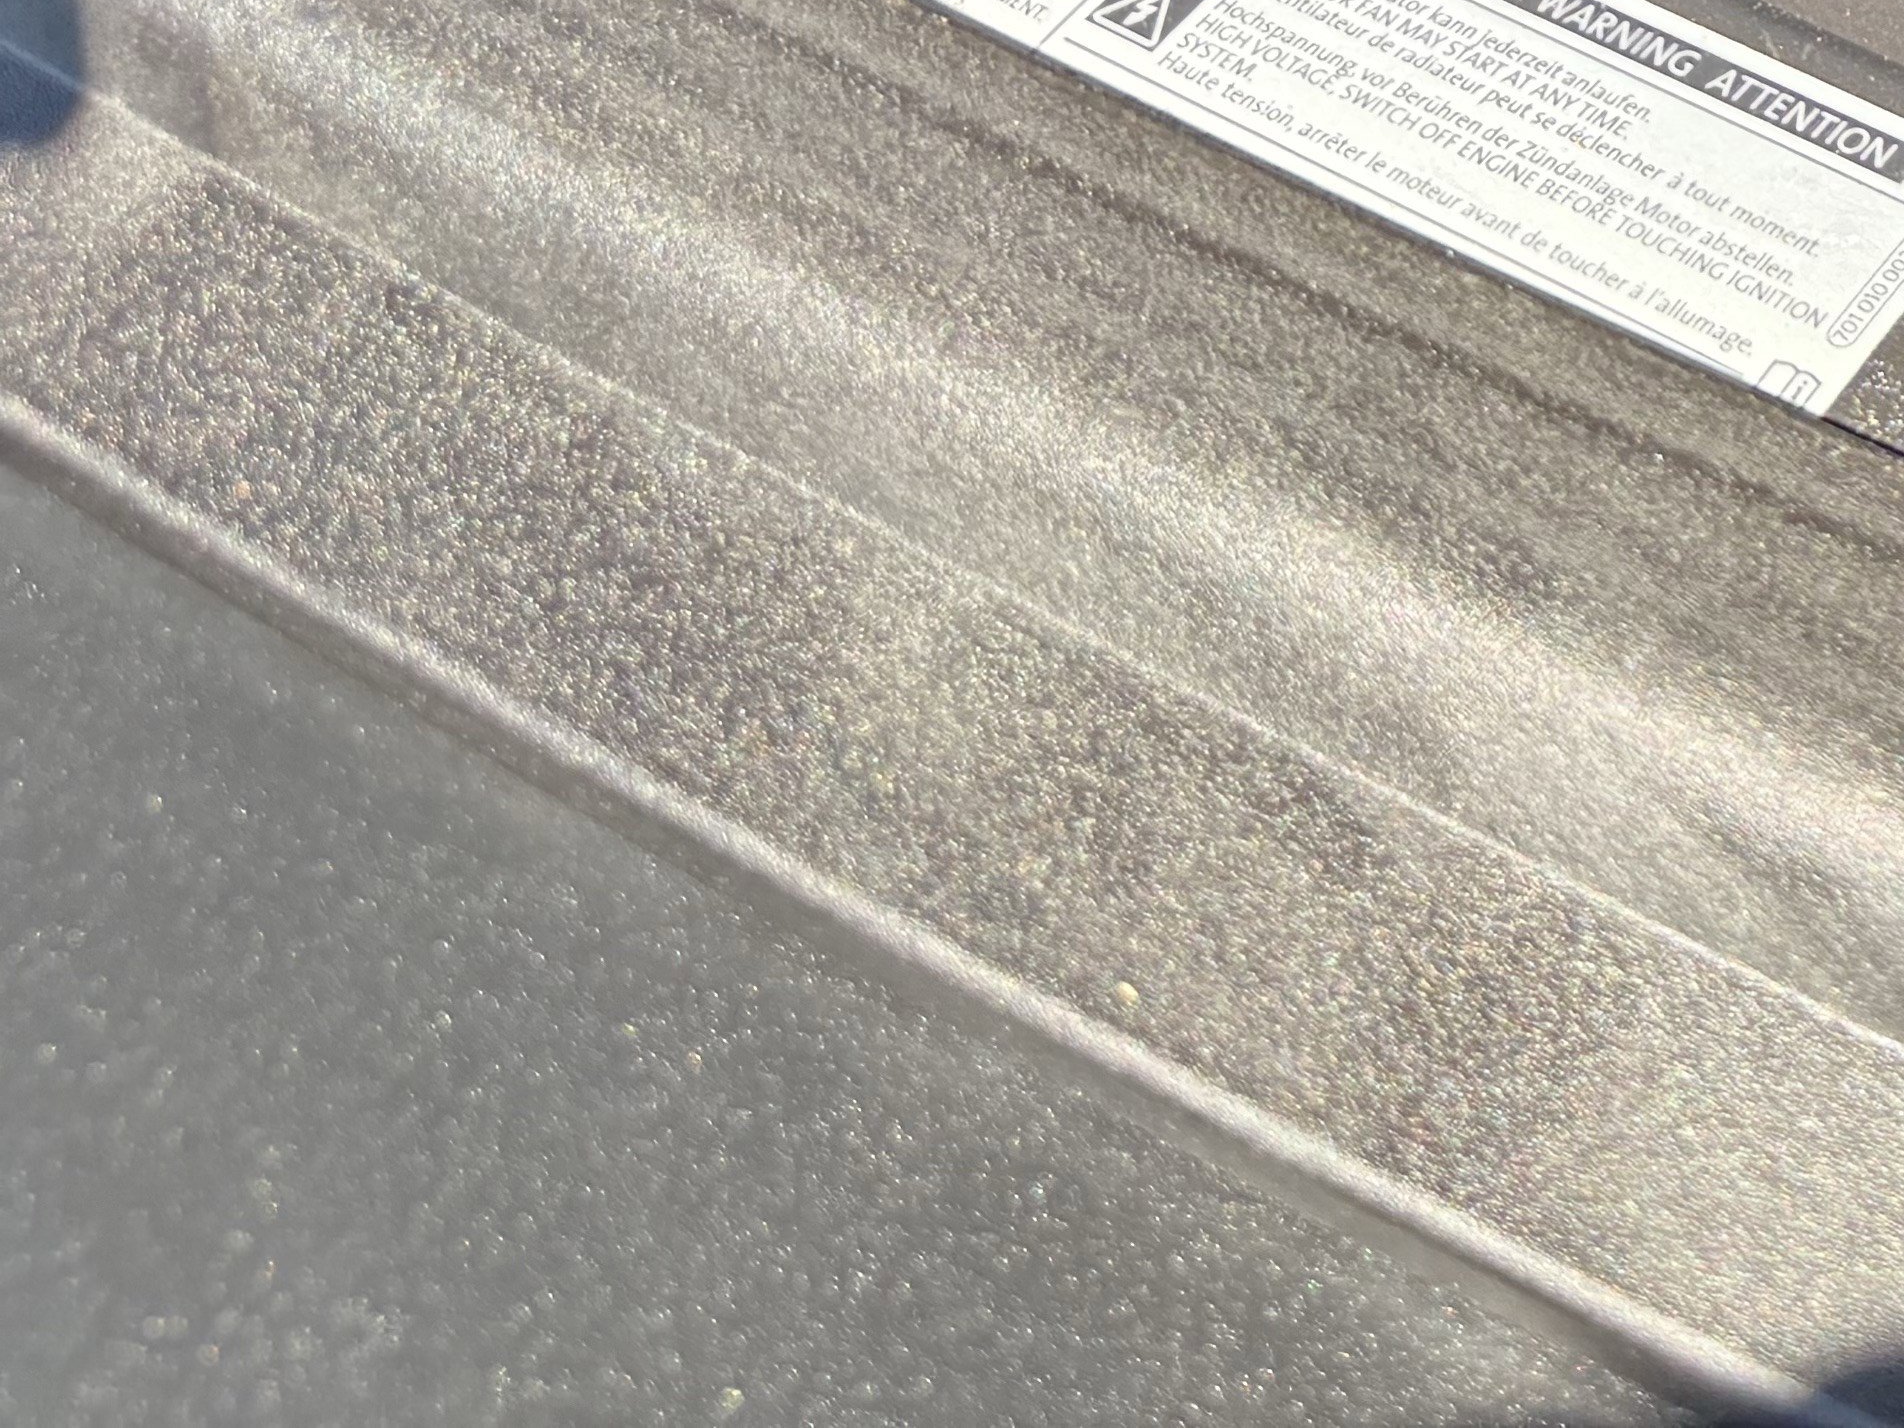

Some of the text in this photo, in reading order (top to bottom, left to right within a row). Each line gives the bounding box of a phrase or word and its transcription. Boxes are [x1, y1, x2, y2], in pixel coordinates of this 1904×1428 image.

[1175, 31, 1258, 82] SYSTEM.
[1393, 16, 1449, 49] MAY
[1441, 39, 1507, 77] START
[1499, 69, 1536, 90] AT
[1528, 81, 1579, 112] ANY
[1575, 101, 1633, 140] TIME.
[1426, 5, 1478, 40] kann
[1470, 28, 1564, 86] jederzeit
[1559, 70, 1651, 123] anlaufen.
[1703, 68, 1899, 169] ATTENTION
[1156, 50, 1220, 91] Haute
[1219, 81, 1295, 133] tension,
[1296, 121, 1367, 162] arrêter
[1363, 150, 1387, 174] le
[1384, 165, 1464, 210] moteur
[1458, 201, 1522, 239] avant
[1518, 228, 1549, 253] de
[1547, 241, 1630, 291] toucher
[1626, 280, 1647, 300] à
[1194, 12, 1829, 329] HIGH VOLTAGE, SWITCH OFF ENGINE BEFORE TOUCHING IGNITION
[1359, 66, 1396, 91] vor
[1390, 80, 1484, 135] Berühren
[1479, 125, 1520, 150] der
[1514, 139, 1635, 209] Zündanlage
[1632, 195, 1702, 238] Motor
[1697, 229, 1794, 287] abstellen.
[1366, 31, 1396, 53] de
[1392, 45, 1486, 95] radiateur
[1477, 87, 1533, 120] peut
[1528, 111, 1557, 131] se
[1554, 121, 1665, 181] déclencher
[1665, 170, 1685, 190] à
[1682, 179, 1730, 213] tout
[1727, 204, 1820, 258] moment.
[1832, 311, 1864, 342] 701
[1855, 281, 1889, 314] 010
